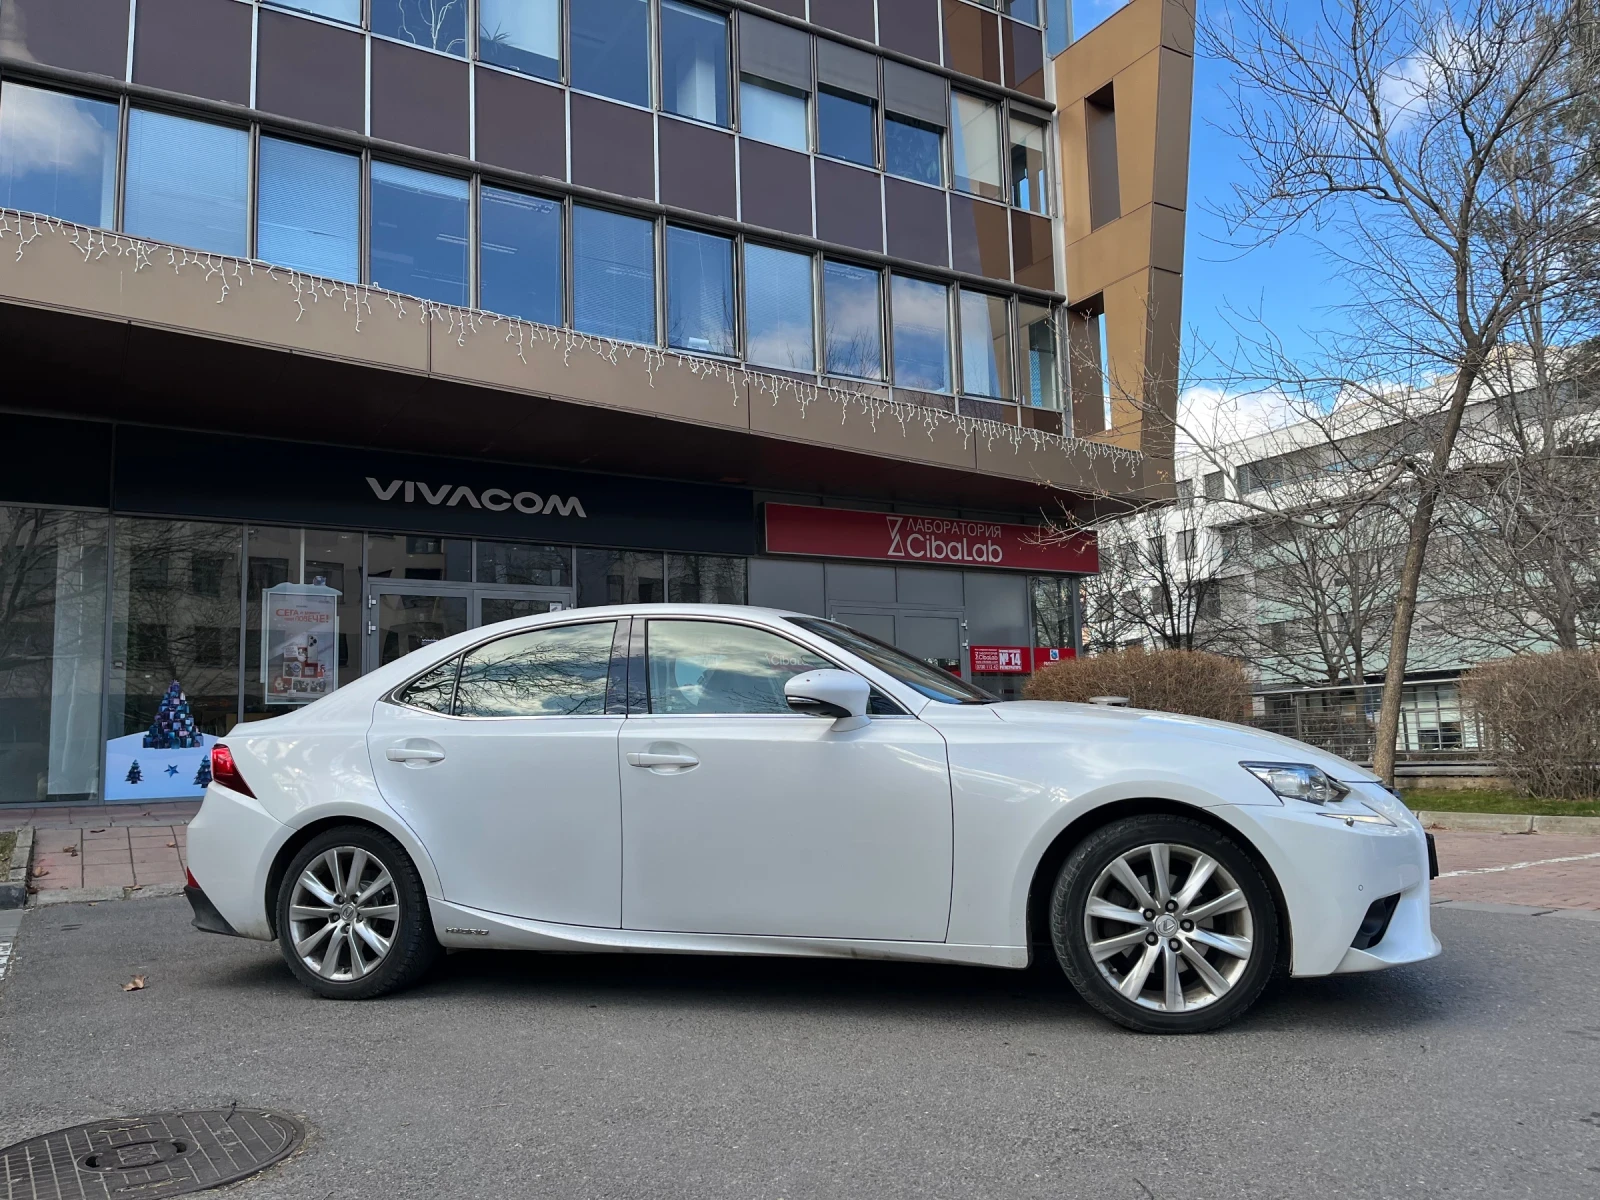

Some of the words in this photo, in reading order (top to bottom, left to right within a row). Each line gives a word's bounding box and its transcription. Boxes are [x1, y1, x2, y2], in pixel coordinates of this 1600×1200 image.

[365, 477, 587, 518] VIVACOM
[907, 518, 1002, 538] ЛАБОРАТОРИЯ
[906, 533, 1003, 563] CibaLab
[275, 608, 299, 617] СЕГА
[1009, 652, 1022, 666] 14
